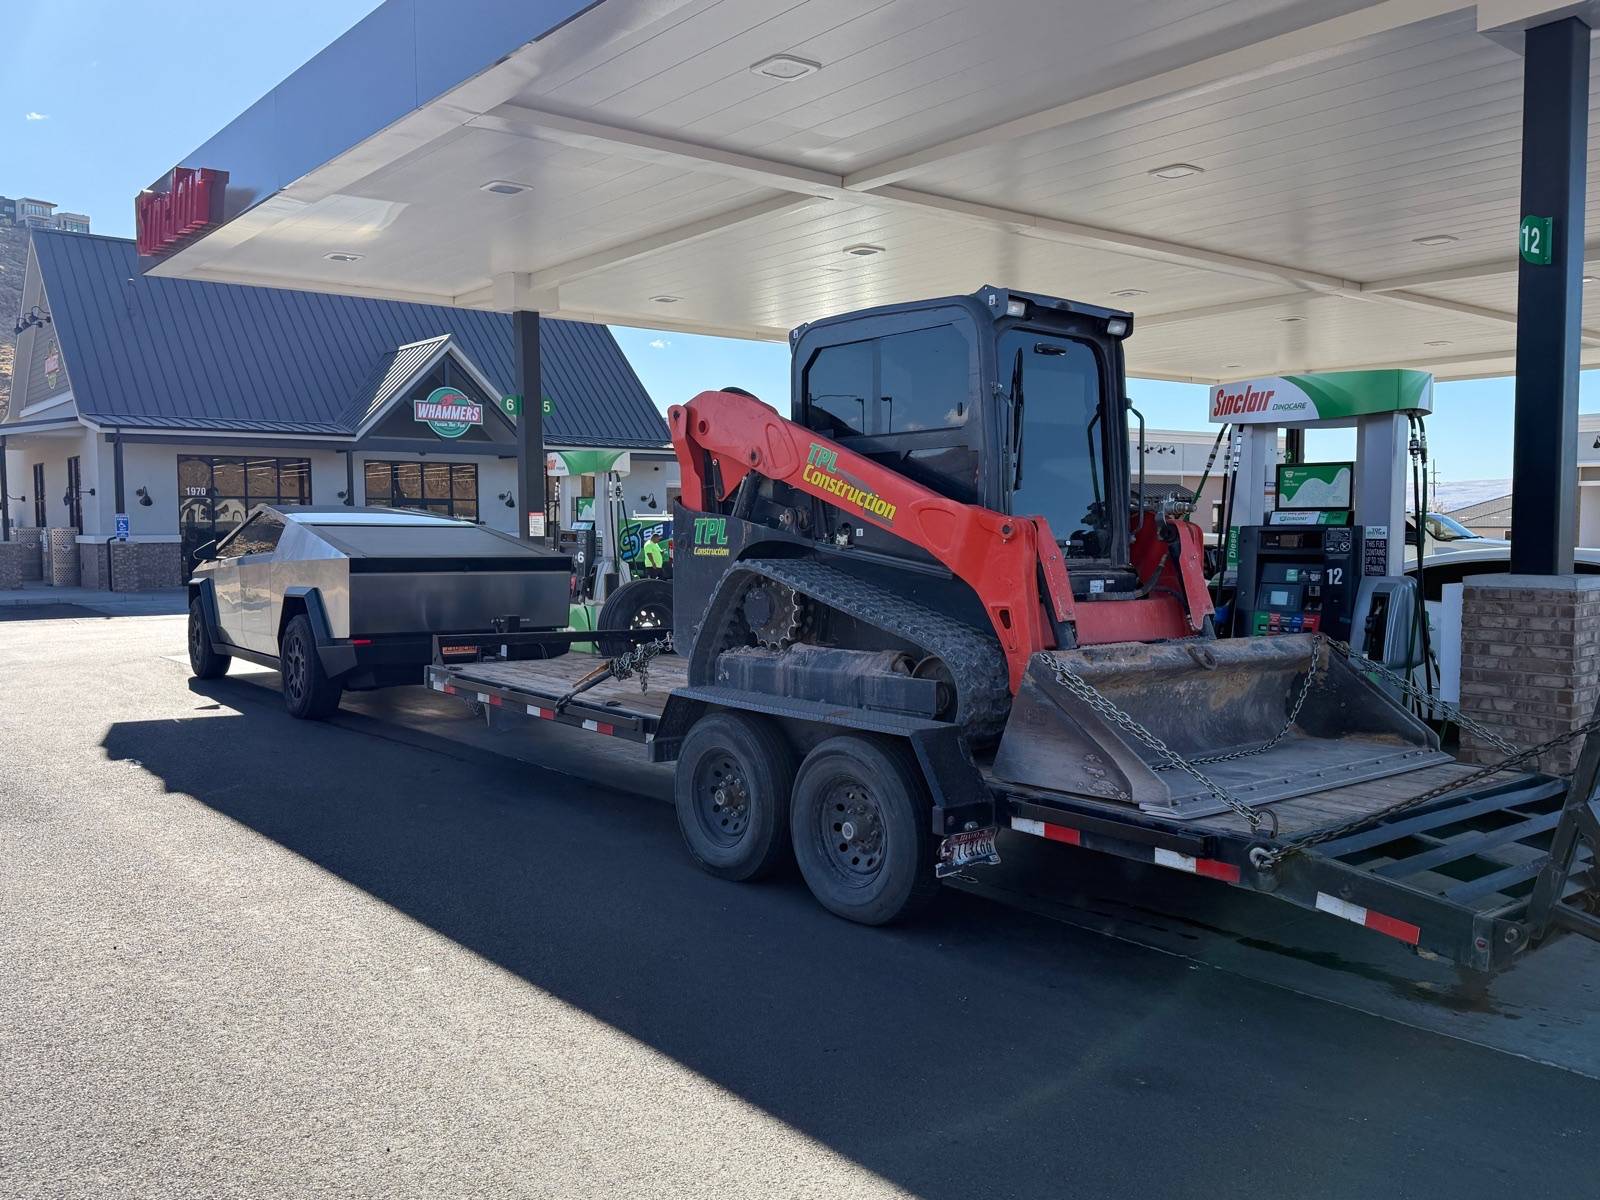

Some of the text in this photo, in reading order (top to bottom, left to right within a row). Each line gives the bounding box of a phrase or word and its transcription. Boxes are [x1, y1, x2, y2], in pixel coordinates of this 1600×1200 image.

[1522, 225, 1540, 254] 12
[506, 399, 514, 411] 6
[543, 401, 550, 412] 5
[1213, 385, 1275, 417] Sinclair
[418, 403, 480, 421] WHAMMERS
[806, 442, 840, 473] TPL
[186, 487, 206, 496] 1970
[802, 464, 897, 521] Construction
[693, 518, 729, 545] TPL
[693, 546, 729, 556] Construction
[1229, 530, 1237, 558] Diesel
[578, 551, 584, 563] 6
[1327, 567, 1342, 585] 12
